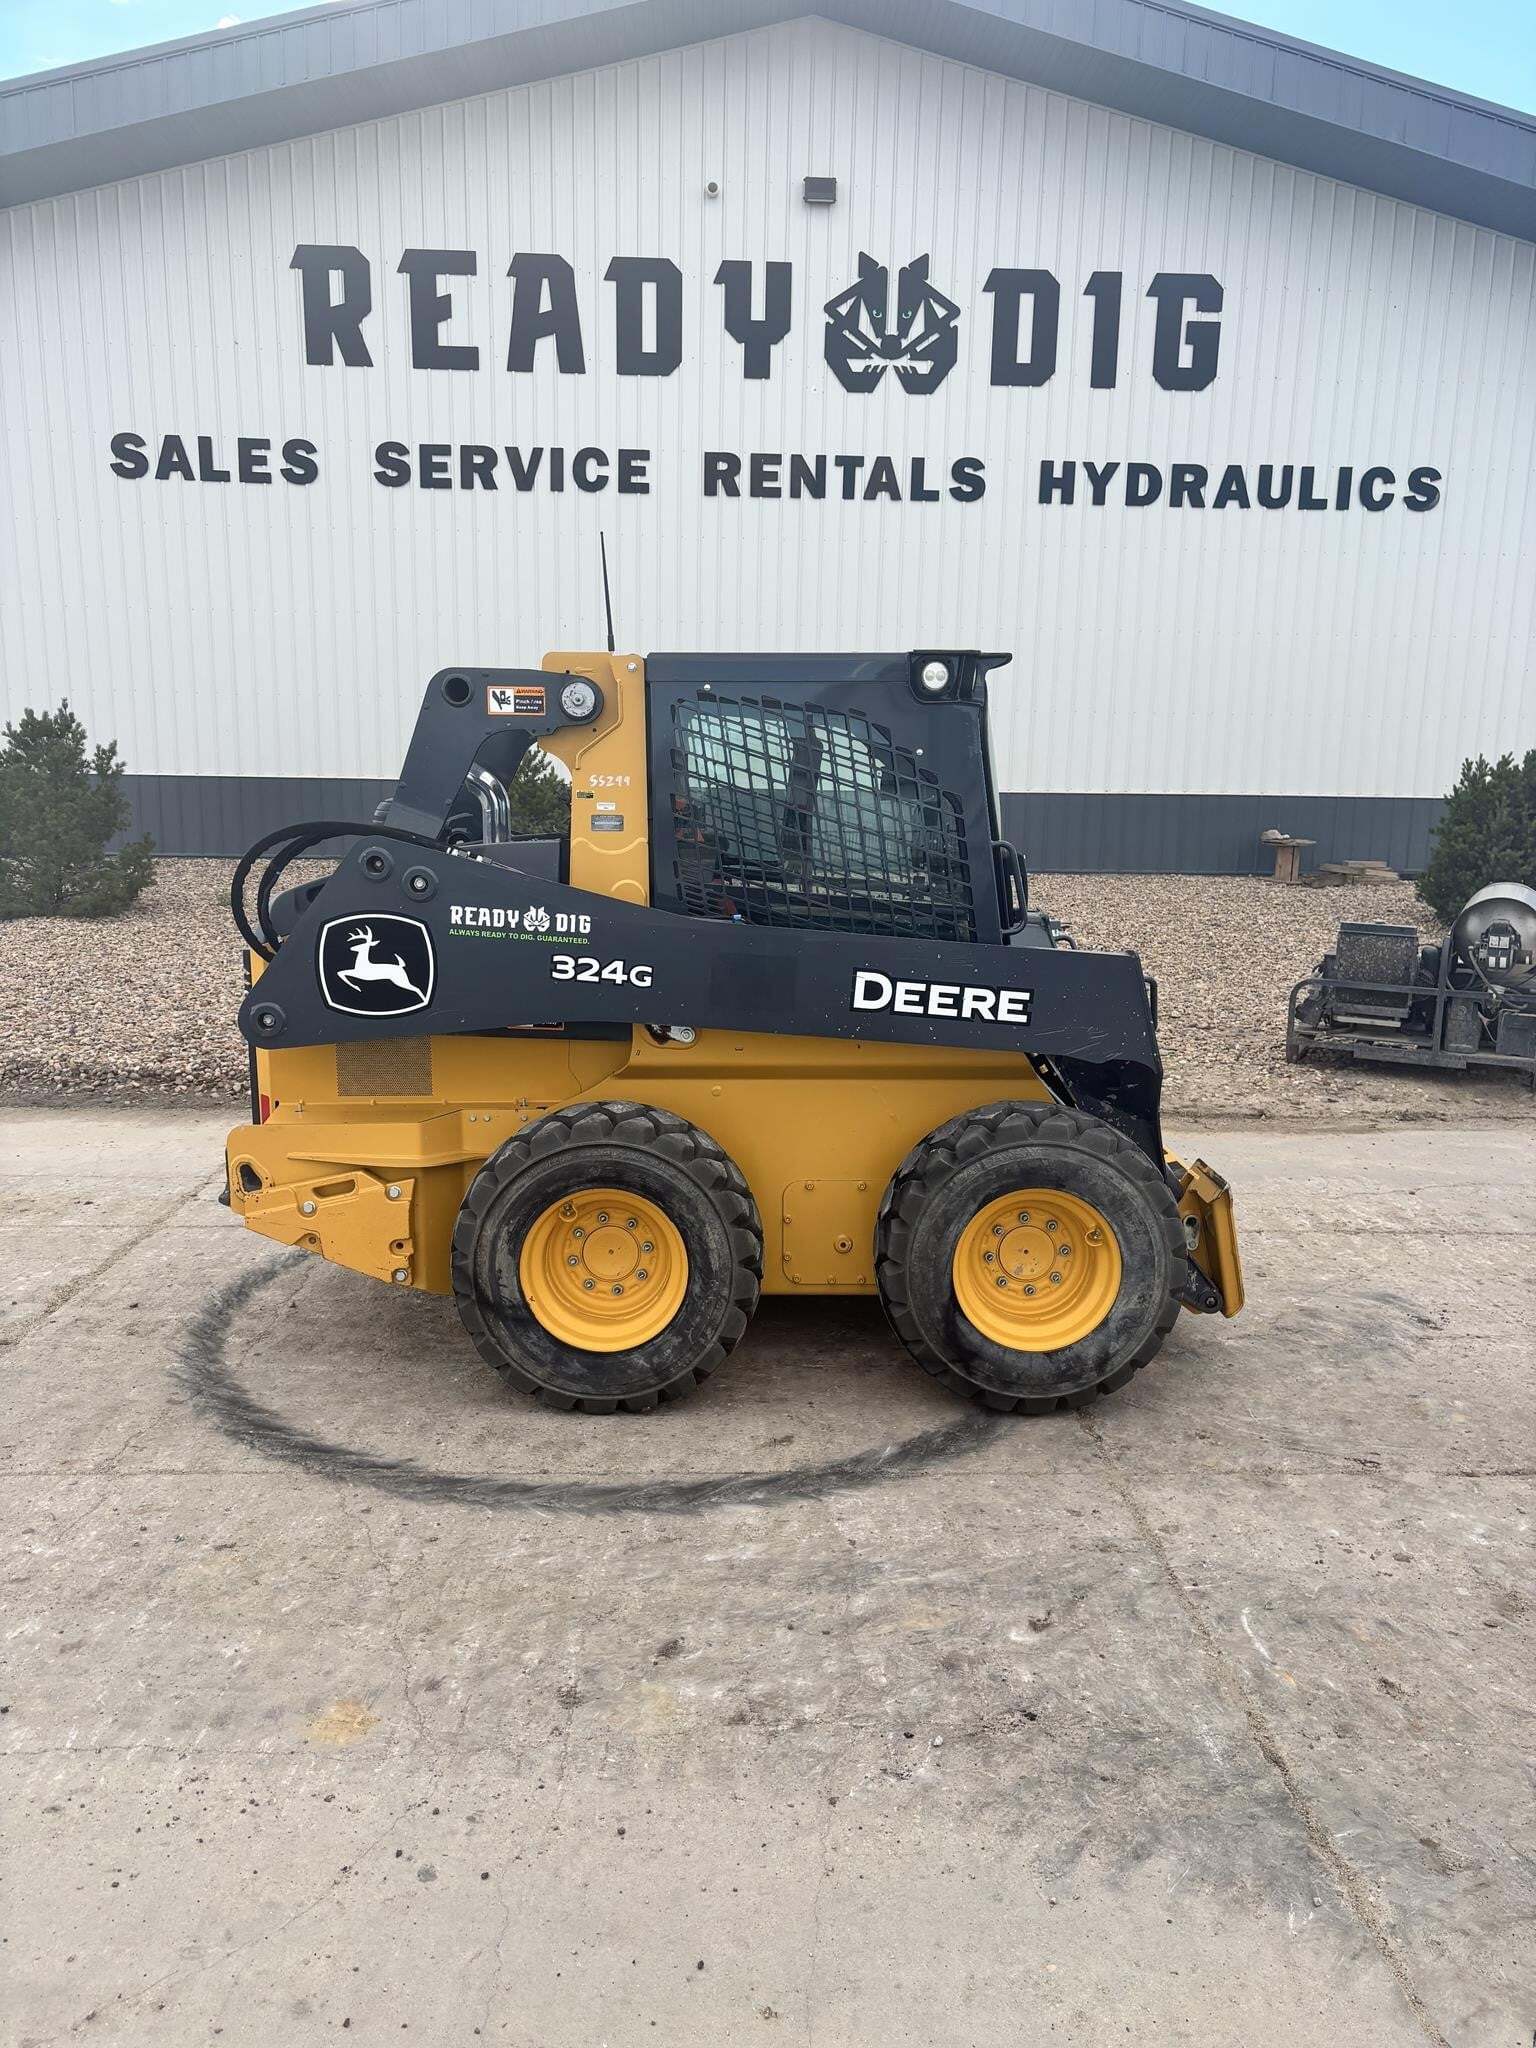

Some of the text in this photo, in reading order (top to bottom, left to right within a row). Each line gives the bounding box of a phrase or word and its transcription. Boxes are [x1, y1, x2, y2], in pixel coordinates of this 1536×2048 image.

[290, 245, 1225, 392] READY DIG
[110, 433, 1442, 512] SALES SERVICE RENTALS HYDRAULICS
[449, 929, 480, 937] ALWAYS
[536, 935, 590, 945] GUARANTEED.
[450, 905, 591, 934] READY DIG
[551, 954, 653, 987] 324G
[853, 971, 1030, 1023] DEERE
